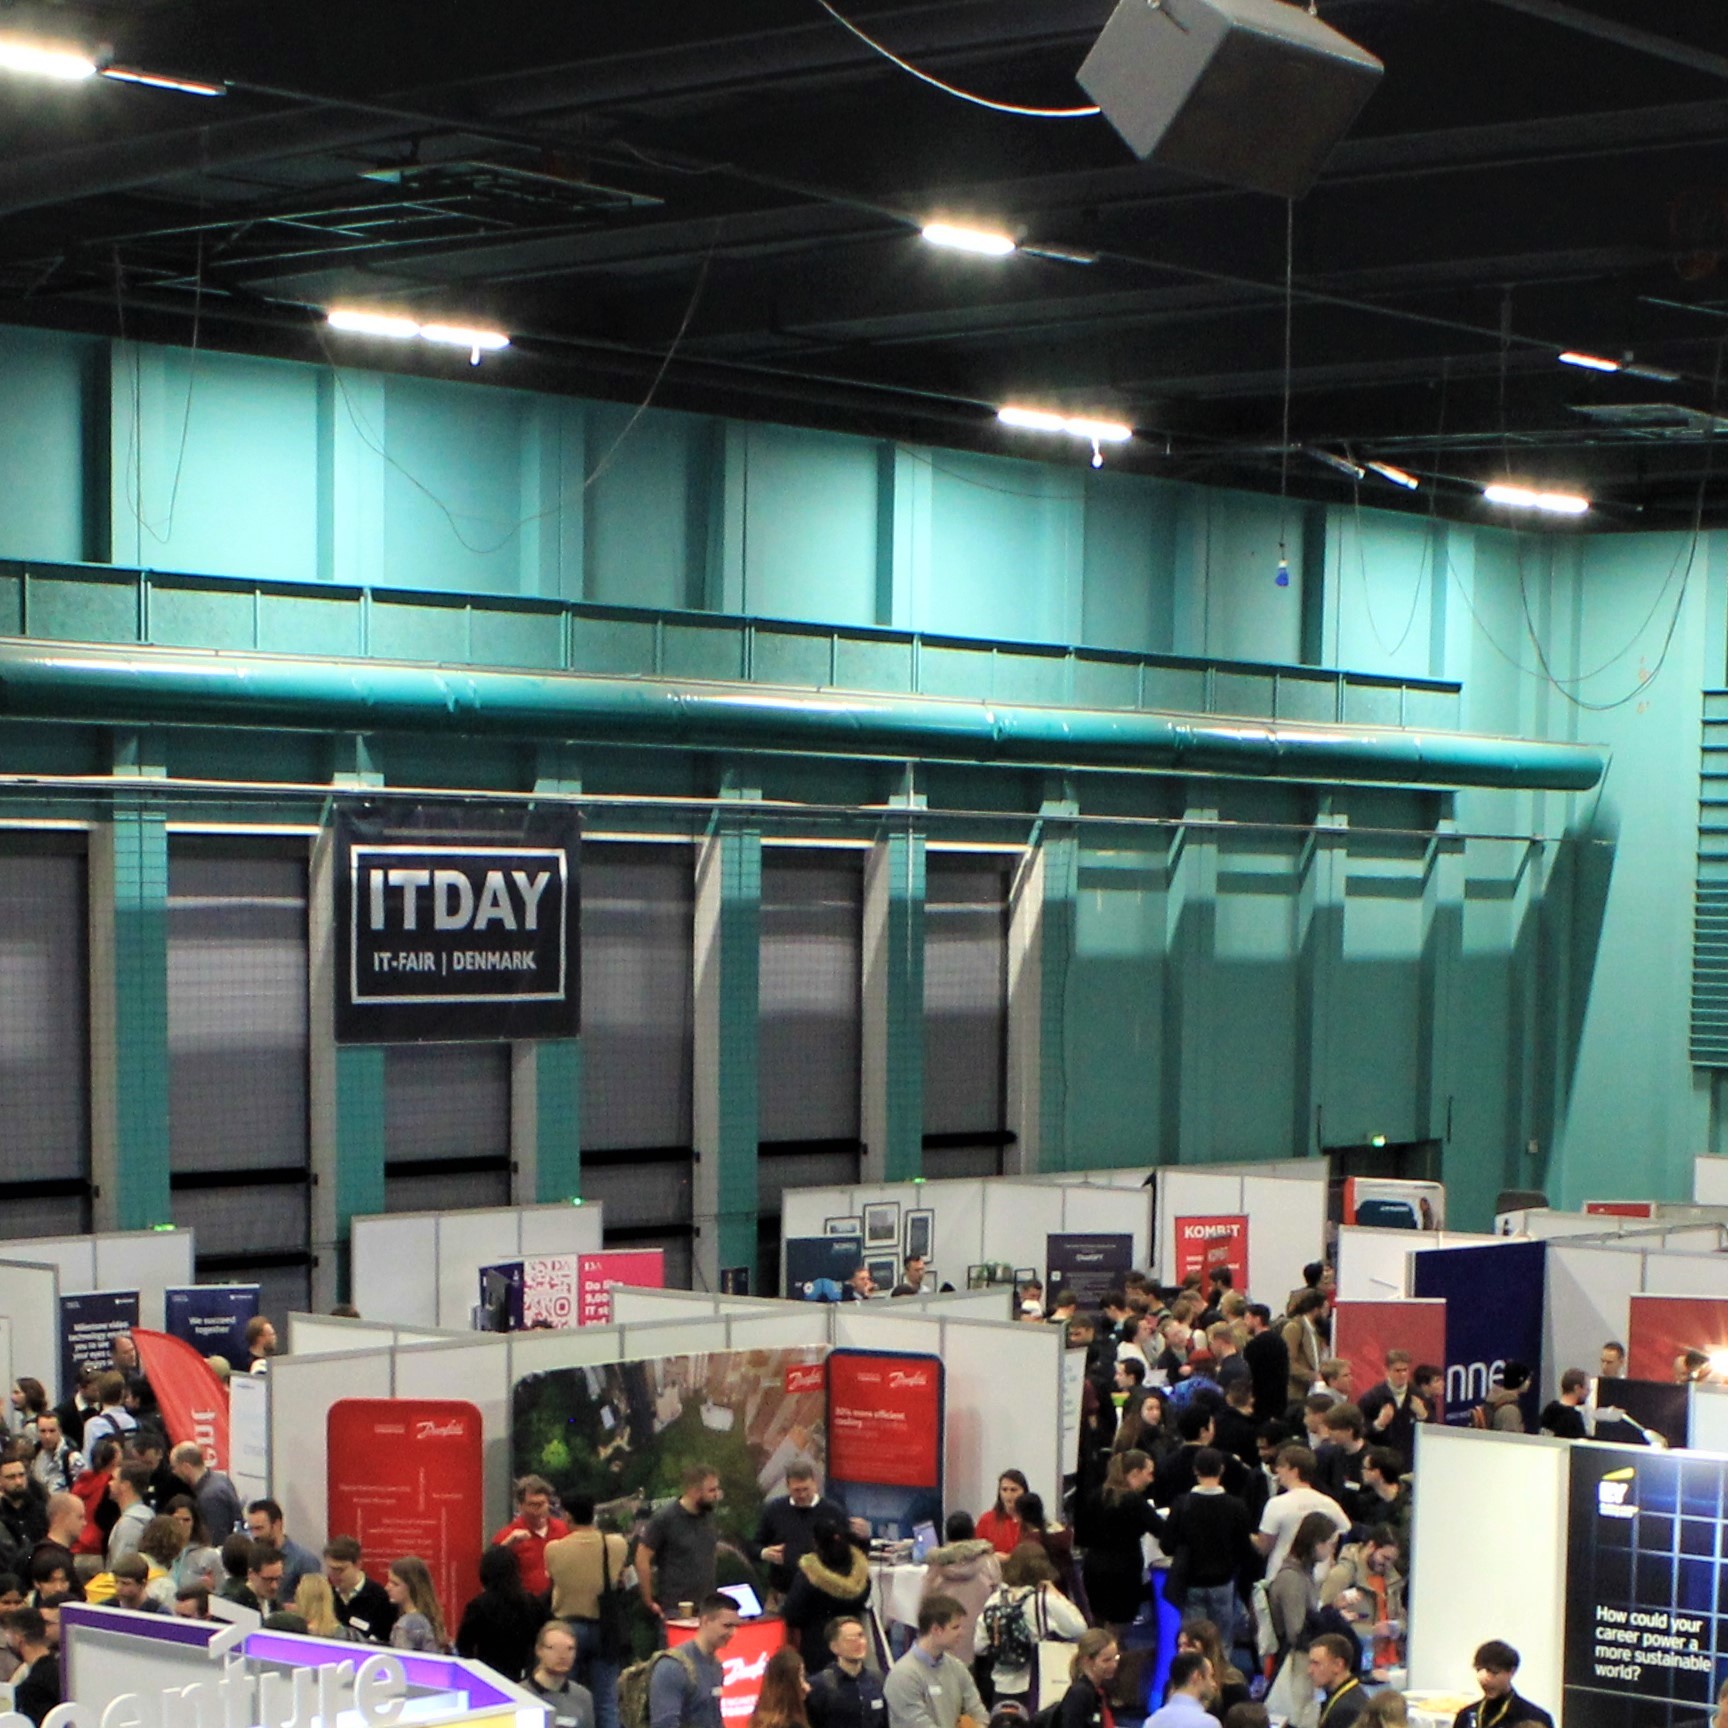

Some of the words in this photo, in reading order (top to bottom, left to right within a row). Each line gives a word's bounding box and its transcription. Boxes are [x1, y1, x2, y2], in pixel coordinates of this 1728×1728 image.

[369, 869, 551, 930] ITDAY
[373, 951, 435, 972] IT-FAIR
[453, 950, 537, 971] DENMARK
[1596, 1605, 1628, 1623] How
[1630, 1611, 1669, 1630] could
[1672, 1617, 1703, 1635] your
[1595, 1626, 1640, 1643] career
[1642, 1631, 1687, 1650] power
[1688, 1638, 1699, 1651] a
[1595, 1645, 1631, 1661] more
[1634, 1649, 1711, 1673] sustainable
[1595, 1663, 1642, 1681] world?
